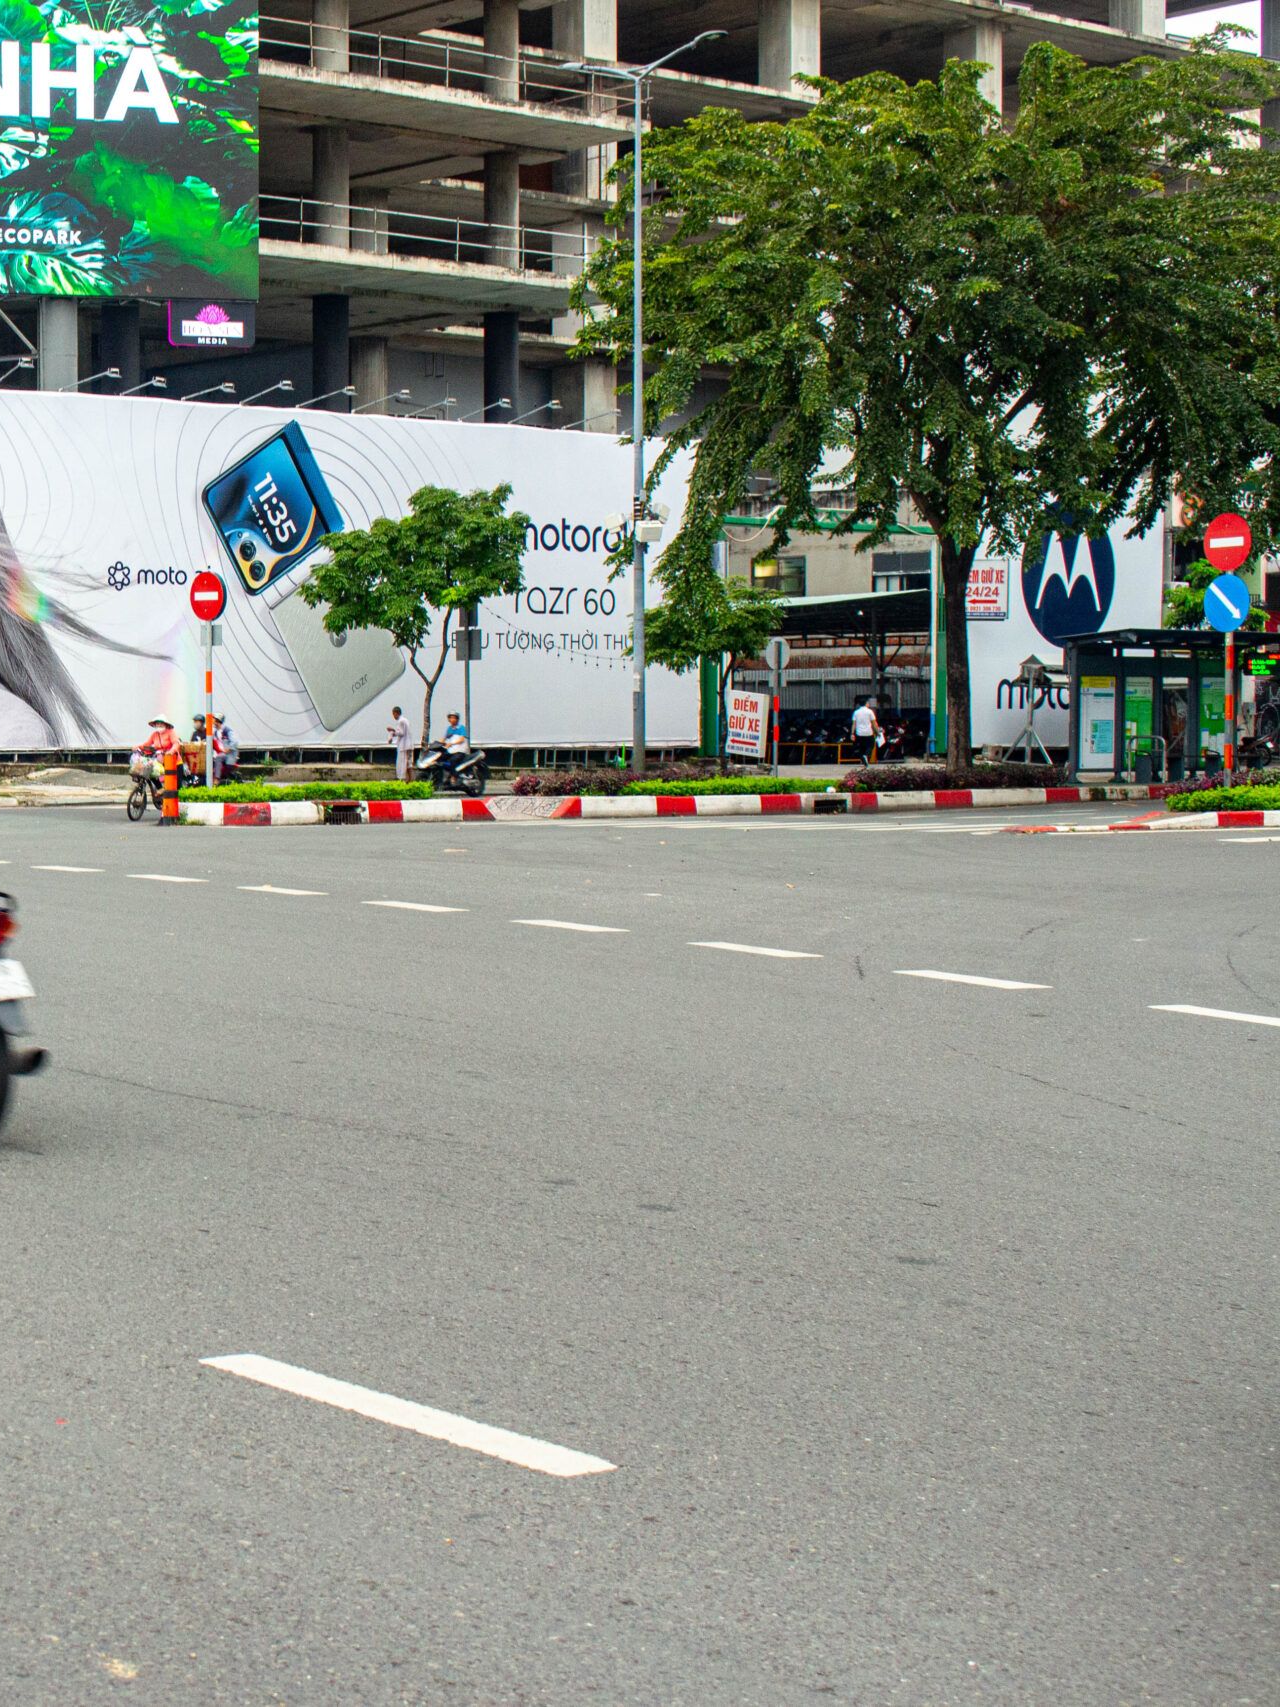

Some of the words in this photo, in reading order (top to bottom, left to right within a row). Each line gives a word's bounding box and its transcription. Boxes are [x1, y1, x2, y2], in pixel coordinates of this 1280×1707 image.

[197, 337, 228, 345] MEDIA
[254, 472, 297, 543] 11:35
[137, 566, 187, 585] moto
[995, 569, 1005, 584] XE
[966, 586, 1000, 597] 24/24
[515, 587, 578, 614] razr
[584, 588, 616, 616] 60
[560, 630, 599, 650] THỜI
[733, 694, 759, 713] ĐIỂM
[729, 713, 746, 730] GIỮ
[747, 717, 760, 733] XE
